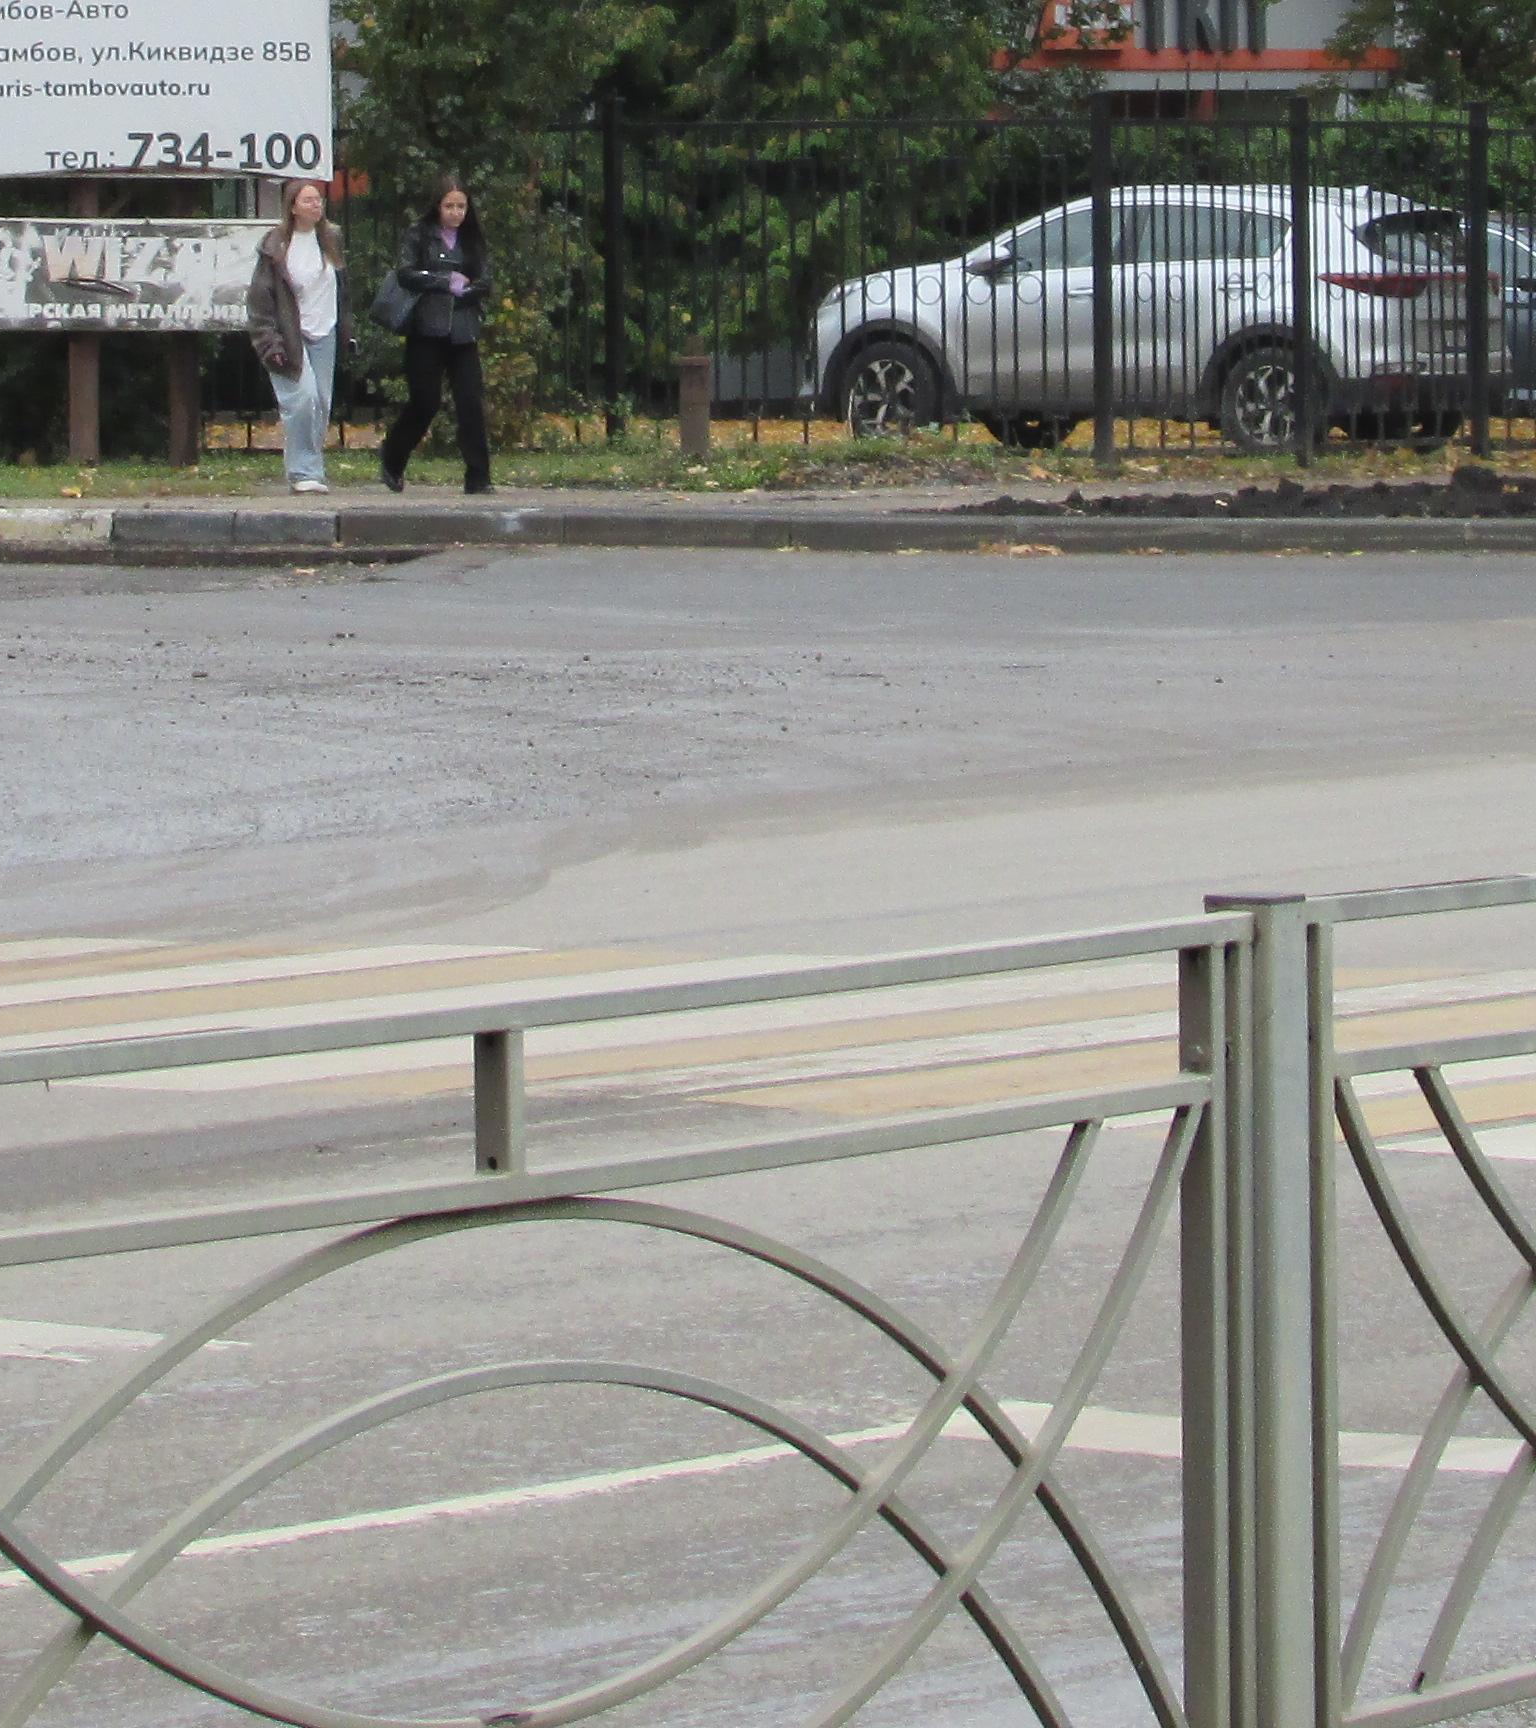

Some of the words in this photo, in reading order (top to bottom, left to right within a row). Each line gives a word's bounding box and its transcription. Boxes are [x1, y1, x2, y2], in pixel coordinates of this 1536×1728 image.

[91, 41, 254, 66] ул.Киквидзе
[262, 41, 312, 62] 85В
[45, 151, 115, 170] тел.:
[127, 132, 322, 171] 734-100
